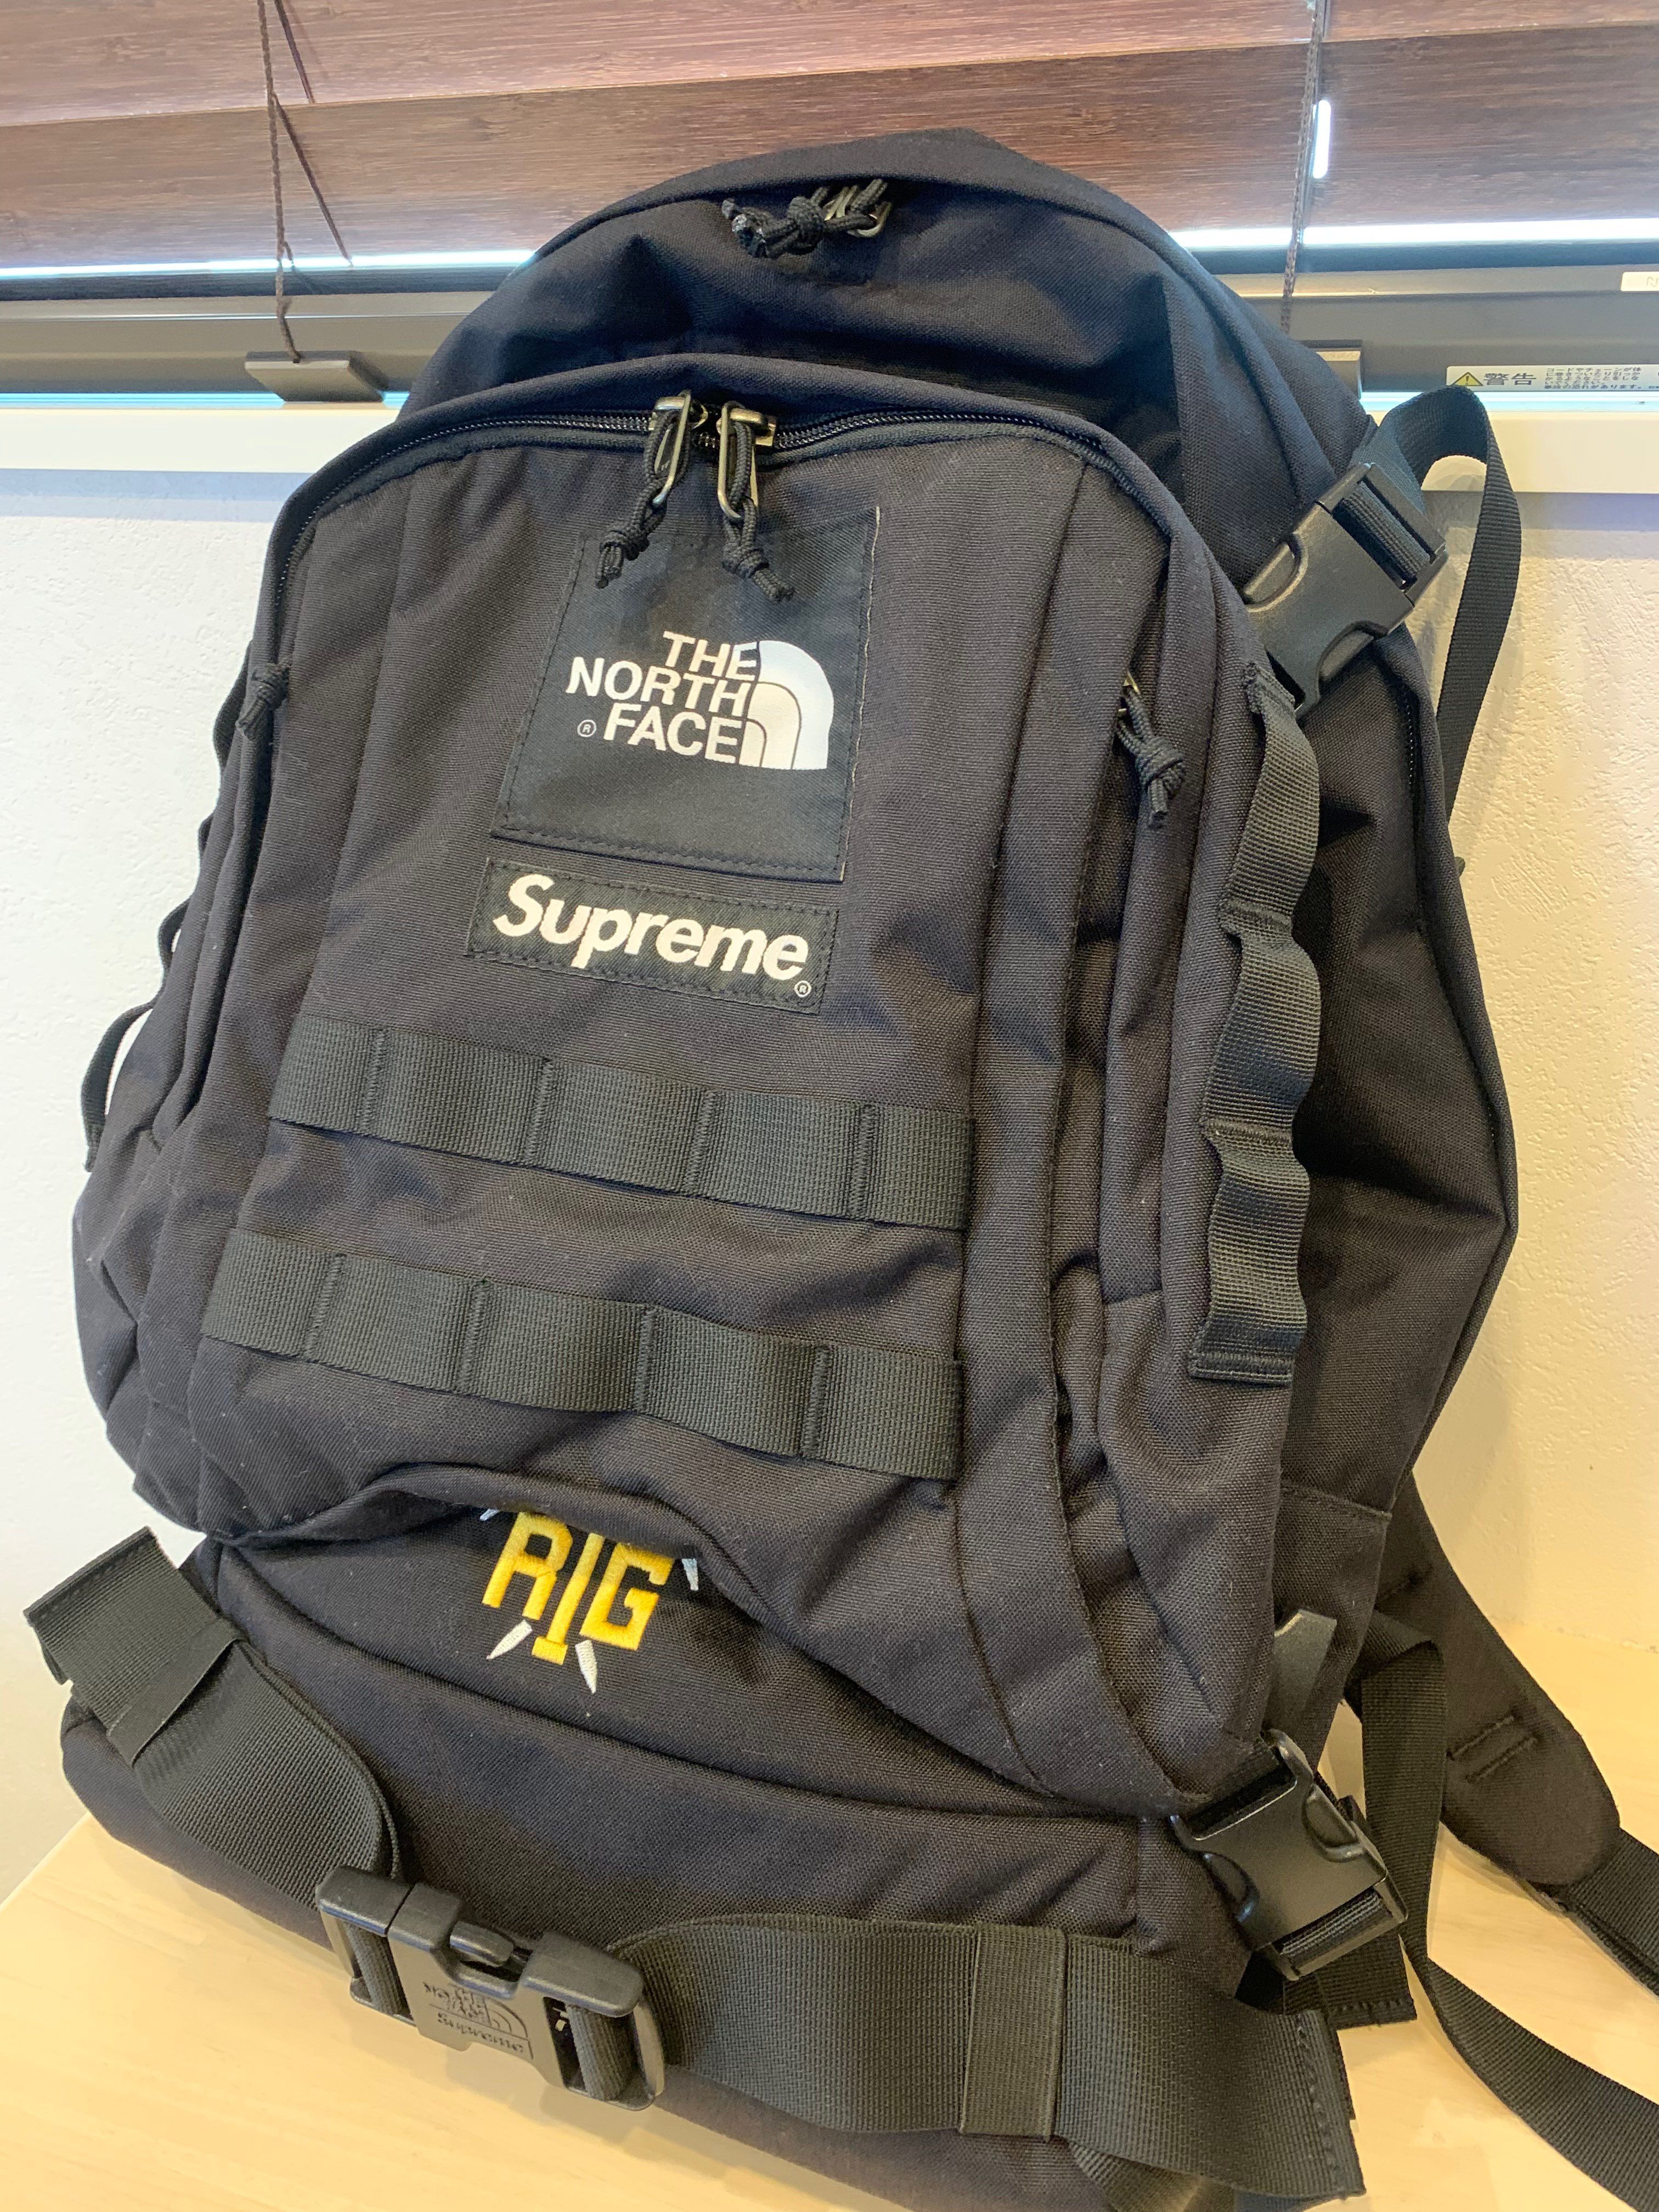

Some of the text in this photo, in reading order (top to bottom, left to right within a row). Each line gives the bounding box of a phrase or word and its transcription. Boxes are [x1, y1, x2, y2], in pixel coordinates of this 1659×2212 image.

[1483, 373, 1536, 385] 警告
[663, 630, 758, 681] THE
[566, 657, 752, 717] NORTH
[603, 703, 743, 764] FACE
[493, 873, 809, 981] Supreme
[482, 1511, 675, 1666] RIG
